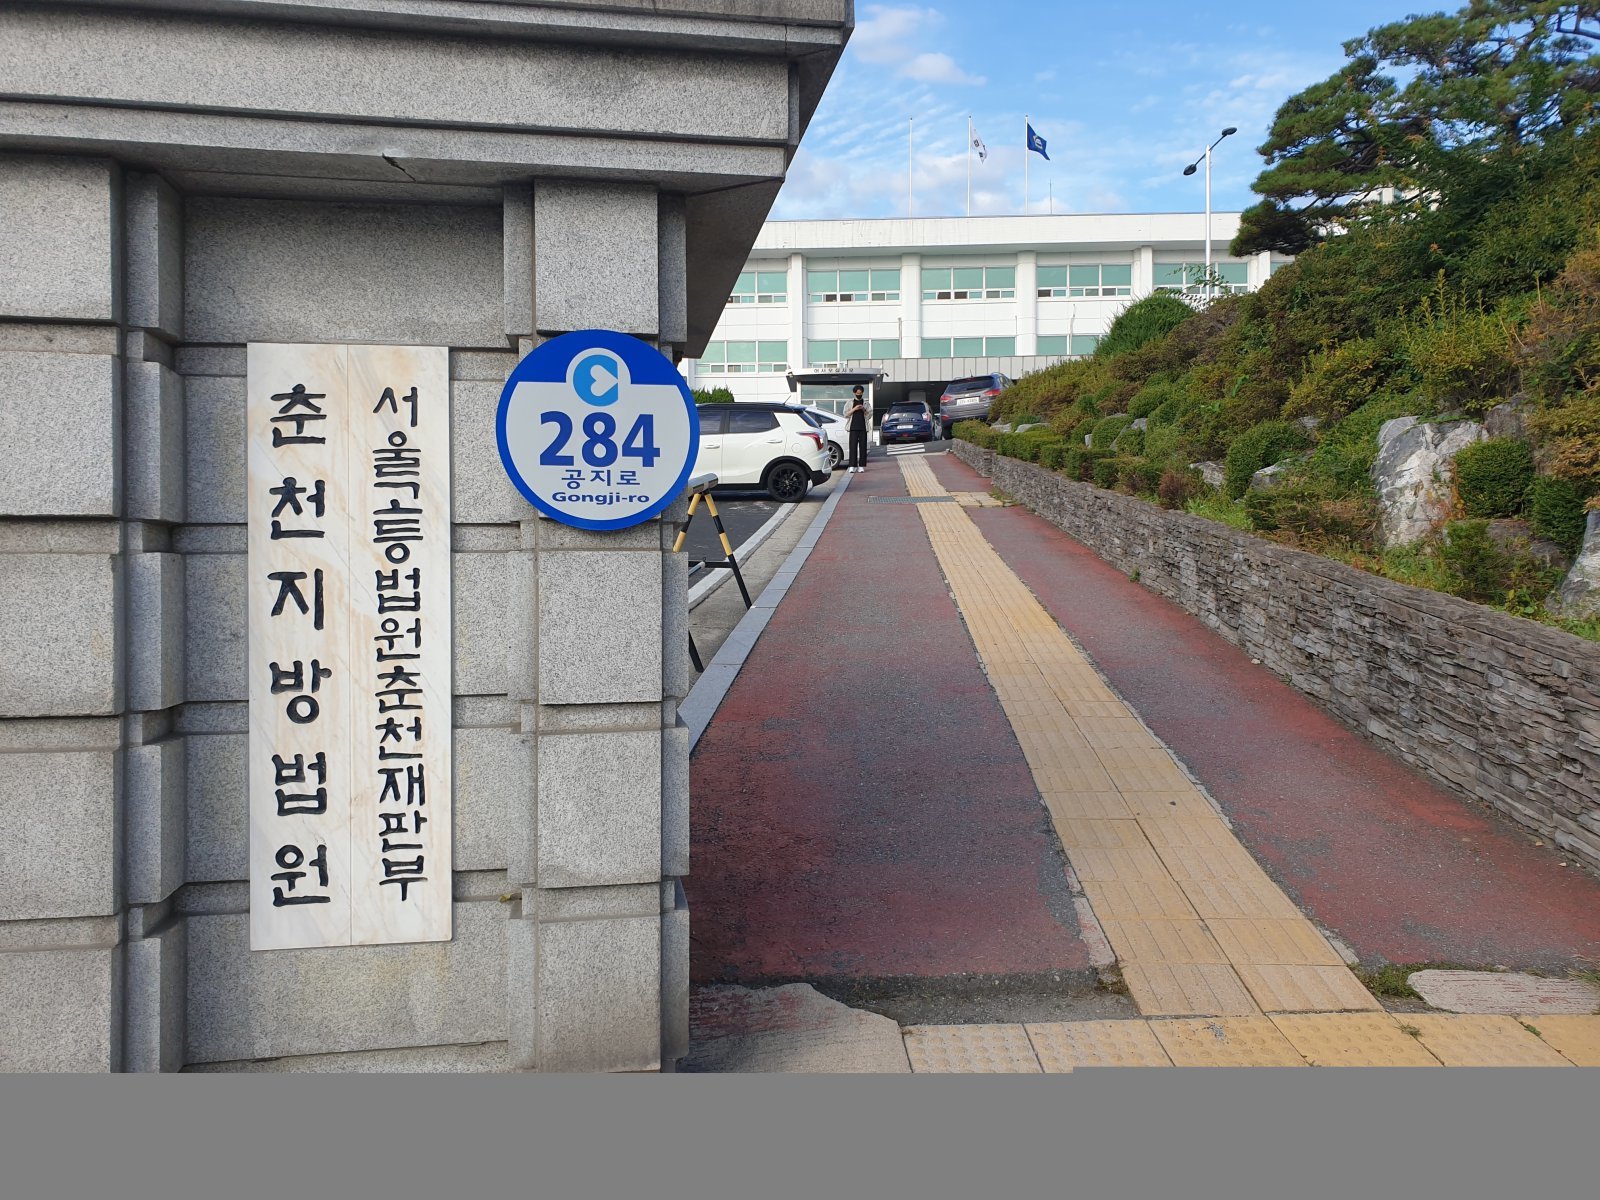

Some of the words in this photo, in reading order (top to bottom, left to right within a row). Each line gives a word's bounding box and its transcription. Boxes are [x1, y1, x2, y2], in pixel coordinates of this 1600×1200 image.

[539, 410, 661, 468] 284
[551, 491, 650, 506] Gongji-ro
[561, 469, 641, 489] 공지로
[268, 384, 332, 907] 춘천지방법원
